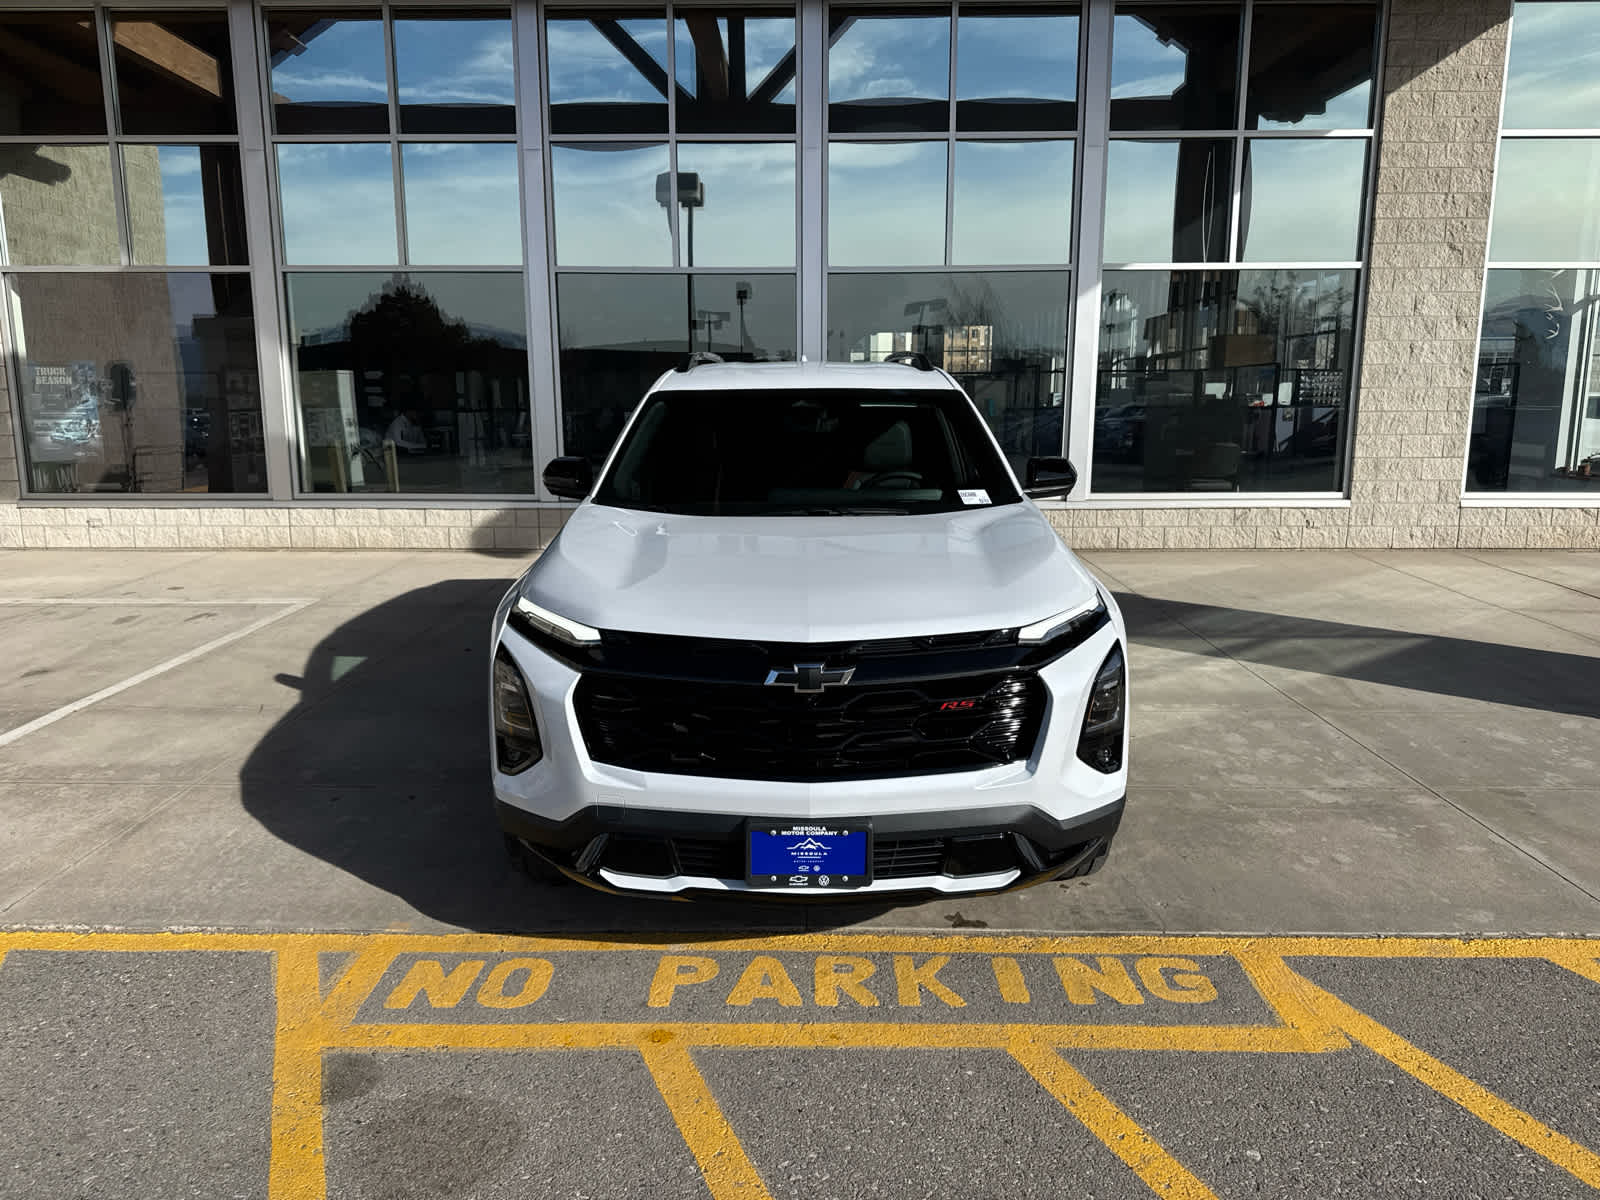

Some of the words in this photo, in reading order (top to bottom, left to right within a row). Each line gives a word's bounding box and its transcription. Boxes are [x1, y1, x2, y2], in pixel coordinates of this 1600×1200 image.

[34, 367, 66, 376] TRUCK
[940, 701, 975, 711] RS
[384, 957, 555, 1010] NO
[647, 955, 1220, 1010] PARKING
